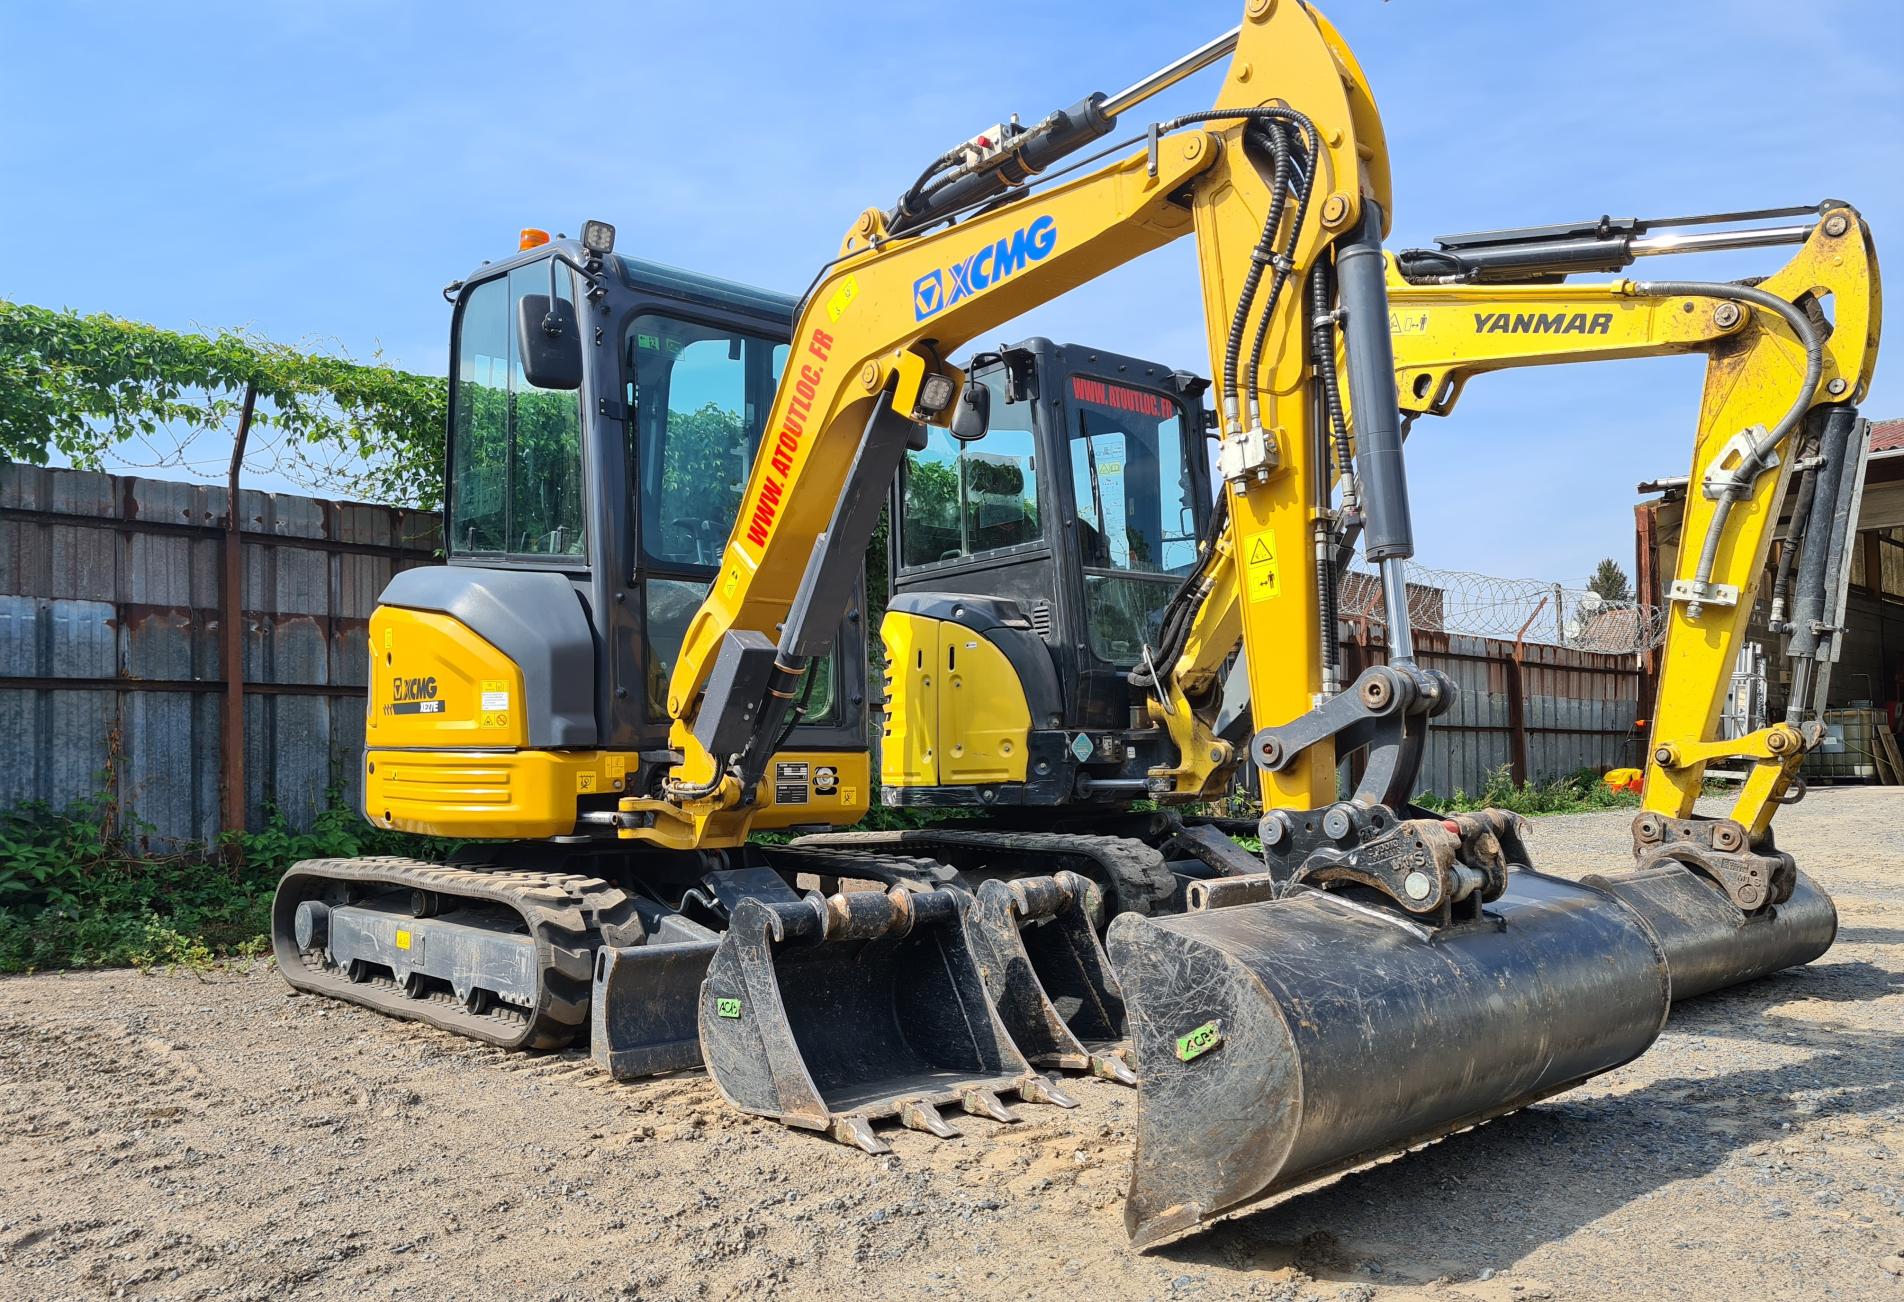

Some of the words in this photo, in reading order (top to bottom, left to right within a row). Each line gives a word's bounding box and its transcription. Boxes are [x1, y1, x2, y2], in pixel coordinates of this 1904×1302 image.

[945, 215, 1057, 308] XCMG
[1474, 313, 1614, 334] YANMAR
[403, 676, 438, 701] XCMG
